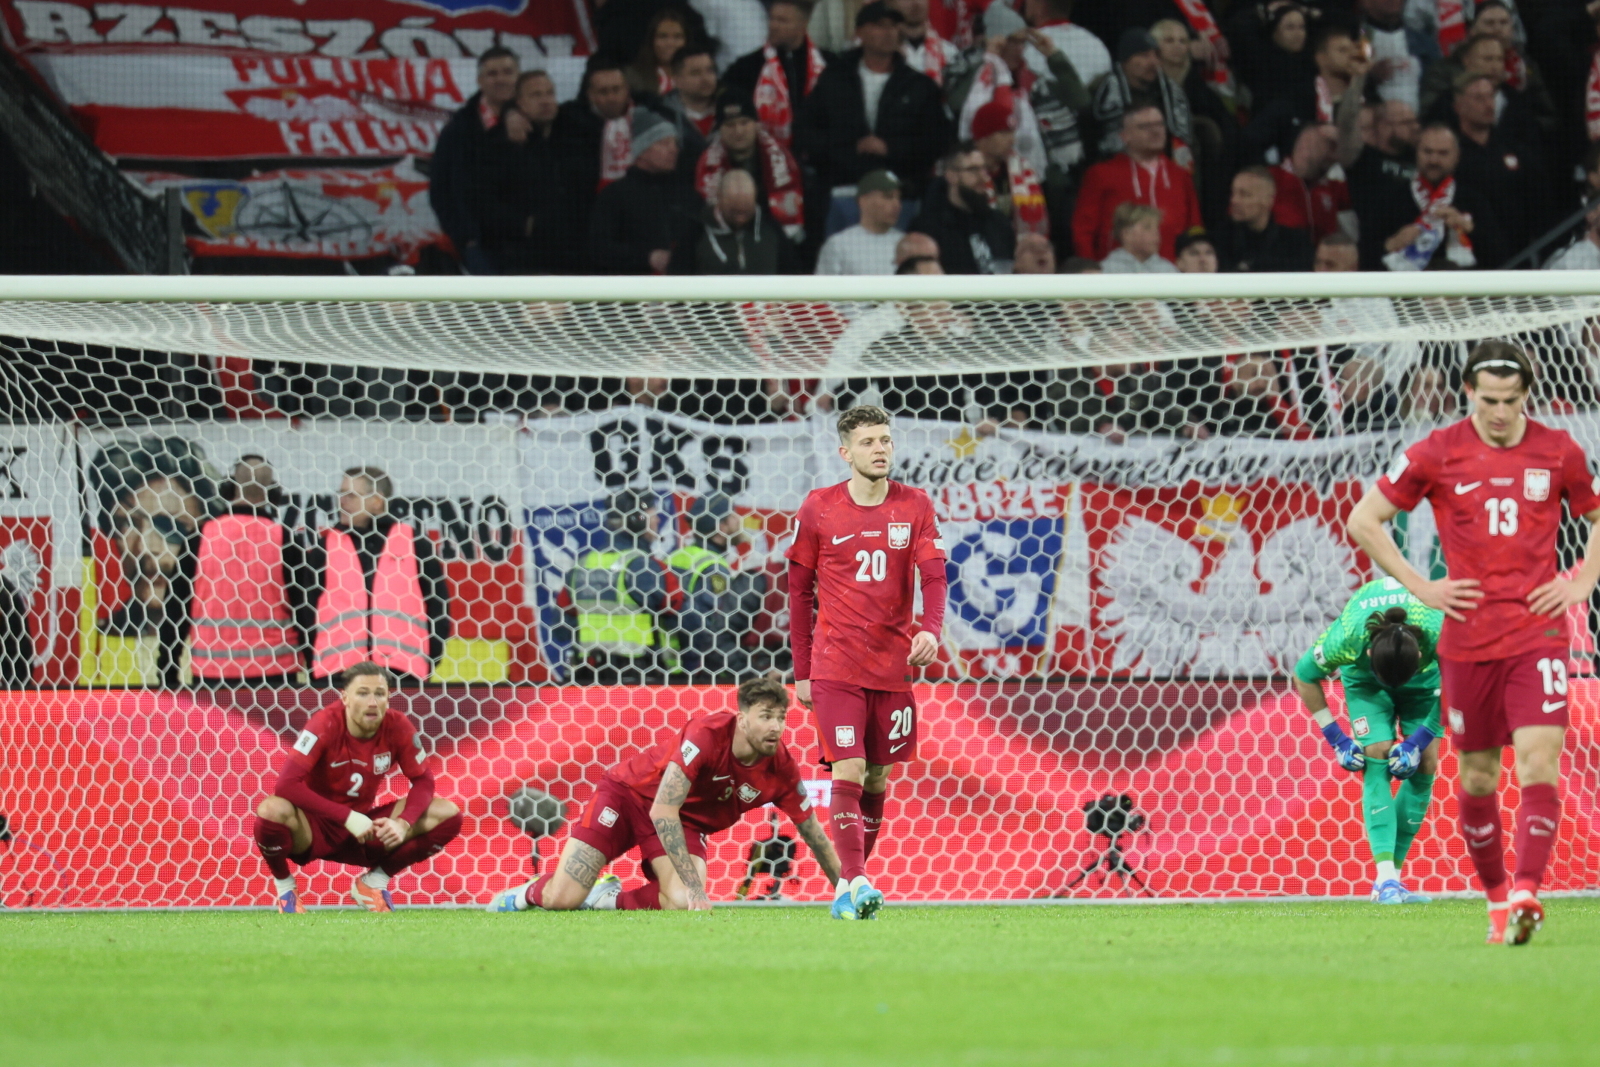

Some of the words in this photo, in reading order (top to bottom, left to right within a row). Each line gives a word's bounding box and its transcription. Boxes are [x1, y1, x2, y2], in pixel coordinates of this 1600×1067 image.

[590, 416, 751, 493] GKS
[1485, 498, 1519, 537] 13
[855, 549, 888, 582] 20
[1359, 592, 1423, 610] RABARA
[1536, 657, 1568, 696] 13
[888, 705, 913, 741] 20
[346, 772, 364, 797] 2
[833, 811, 859, 821] POLSKA
